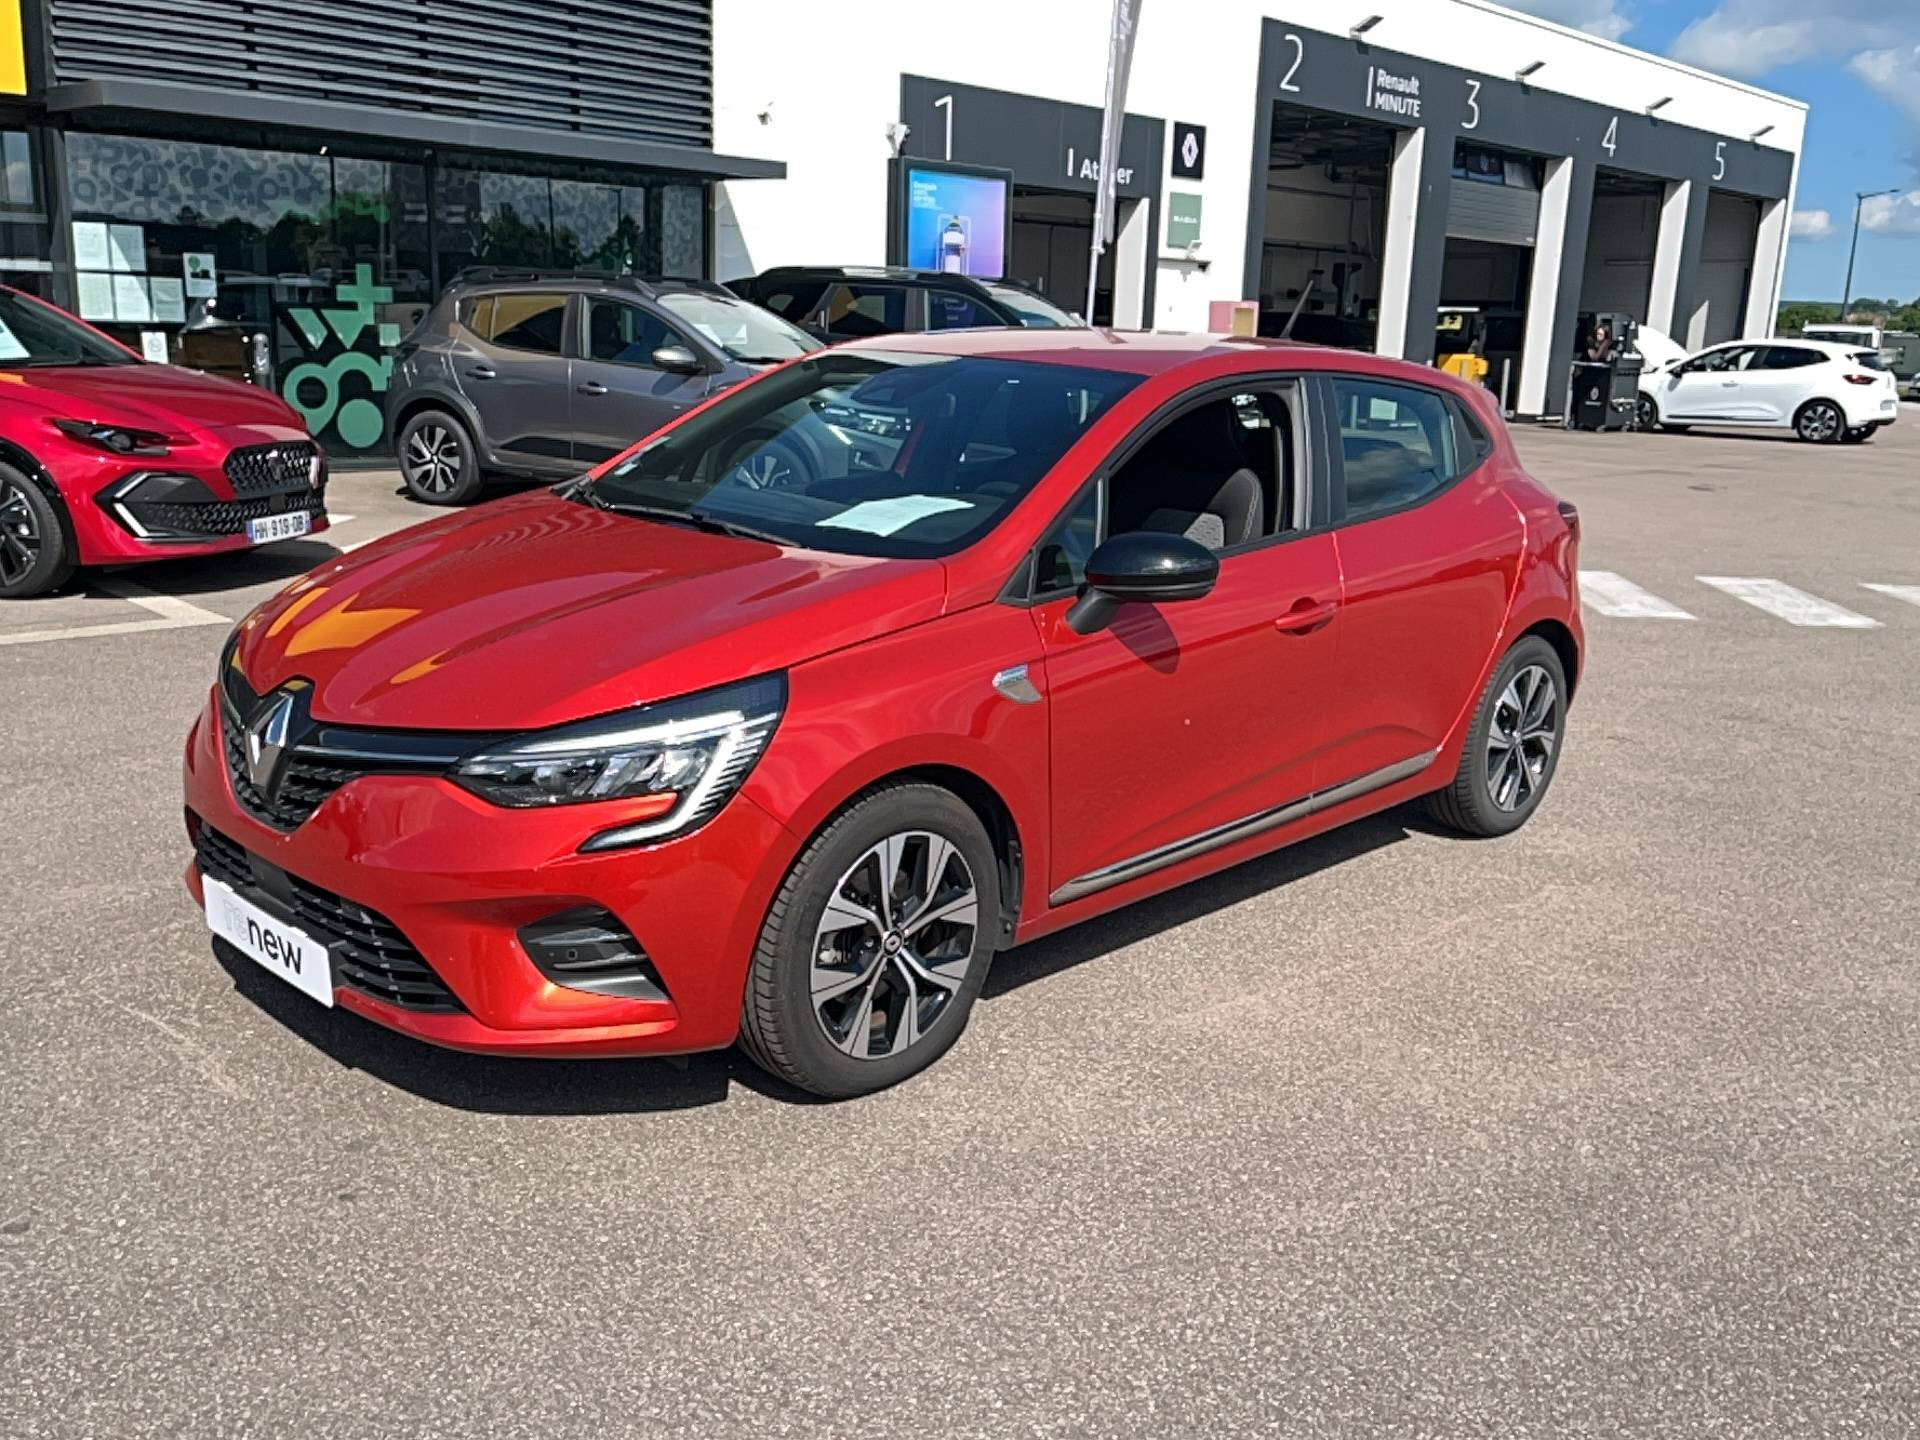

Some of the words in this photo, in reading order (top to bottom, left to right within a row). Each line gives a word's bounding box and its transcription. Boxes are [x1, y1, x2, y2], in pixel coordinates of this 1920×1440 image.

[1280, 33, 1303, 92] 2
[1376, 67, 1421, 96] Renault
[1374, 91, 1422, 118] MINUTE
[1461, 78, 1481, 129] 3
[934, 94, 953, 161] 1
[1601, 116, 1619, 158] 4
[1079, 158, 1135, 185] Ater
[1711, 141, 1727, 180] 5
